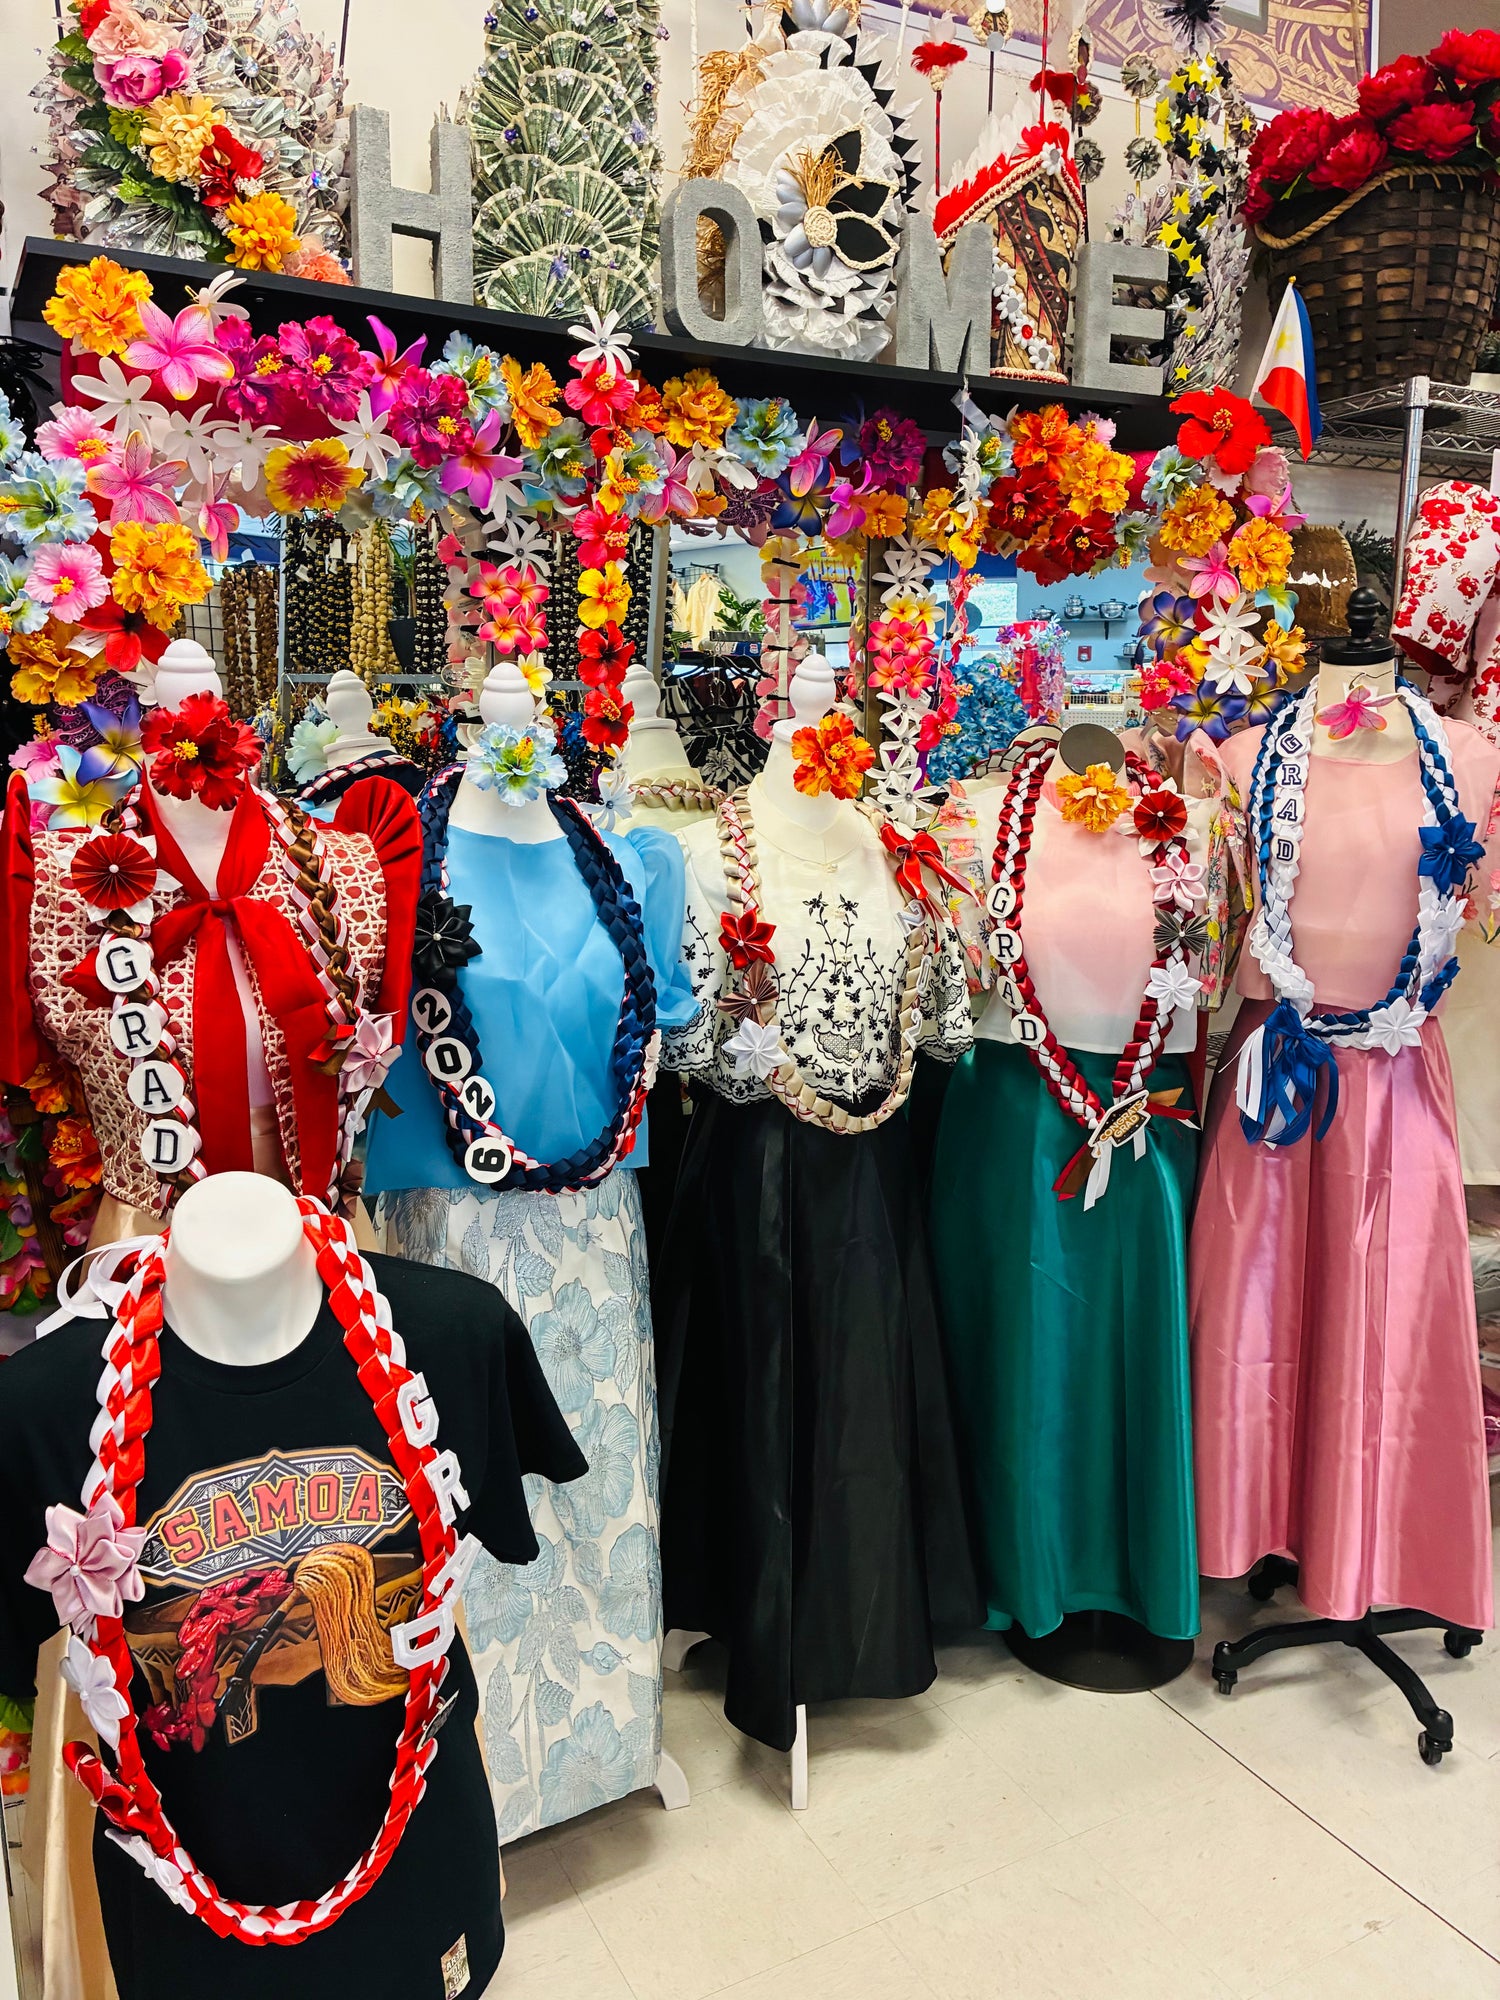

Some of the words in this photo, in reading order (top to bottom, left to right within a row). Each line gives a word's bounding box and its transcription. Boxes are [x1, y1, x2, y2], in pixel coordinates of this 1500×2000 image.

[350, 103, 1169, 396] HOME
[1276, 733, 1303, 862] GRAD
[992, 886, 1037, 1041] GRAD
[105, 945, 179, 1166] GRAD
[416, 992, 506, 1172] 2026
[1100, 1100, 1144, 1141] CONGRATS
[1113, 1114, 1140, 1138] GRAD
[158, 1471, 384, 1567] SAMOA
[390, 1371, 483, 1671] GRAD
